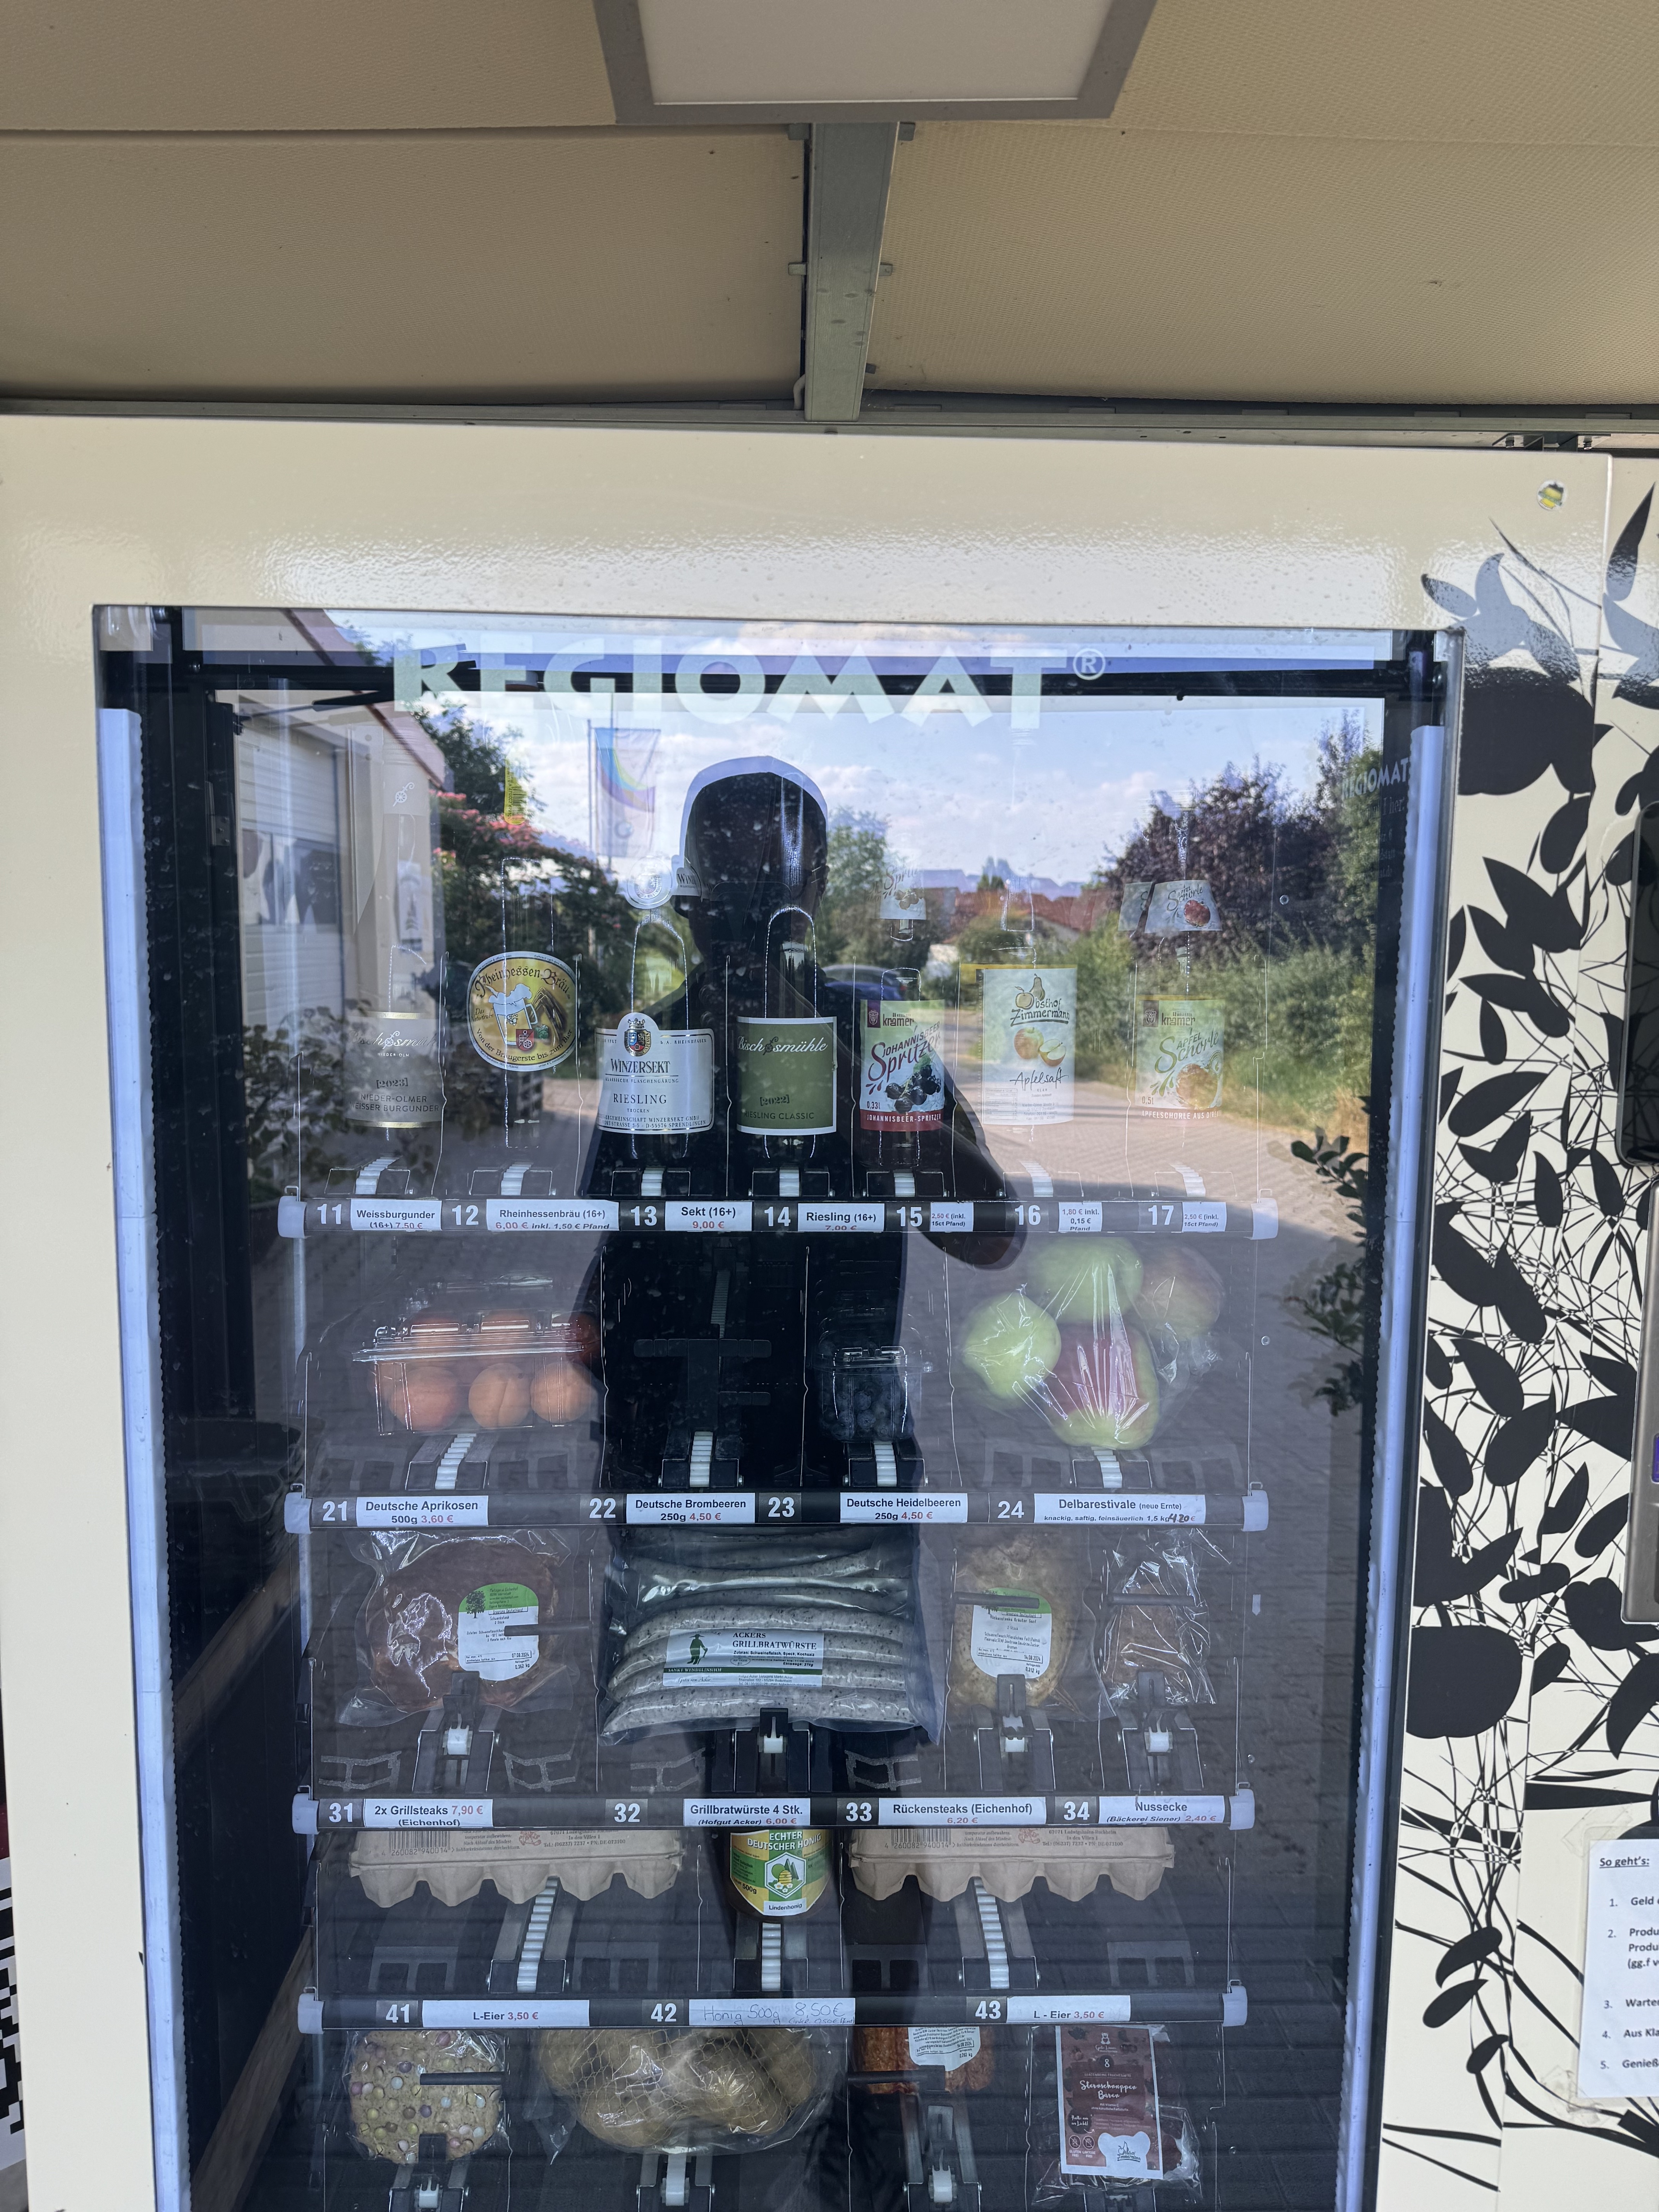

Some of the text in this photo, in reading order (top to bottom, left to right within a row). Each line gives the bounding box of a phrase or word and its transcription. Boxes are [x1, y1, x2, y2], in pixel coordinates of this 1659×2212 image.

[1010, 1009, 1070, 1025] Zimmermann
[1176, 1032, 1201, 1049] APFEL
[485, 1042, 495, 1052] der
[550, 1042, 563, 1055] zum
[611, 1058, 670, 1073] WINZERSEKT
[1010, 1067, 1069, 1091] Apfelsaft
[361, 1094, 427, 1103] NIEDER-OLMER
[613, 1093, 667, 1104] RIESLING
[867, 1114, 941, 1122] JOHANNISBEER-SPRITZER
[1142, 1110, 1190, 1120] APFELSCHORLE
[317, 1204, 342, 1224] 11
[357, 1210, 435, 1221] Weissburgunder
[452, 1205, 479, 1225] 12
[500, 1208, 605, 1219] Rheinhessenbräu (16+)
[630, 1206, 657, 1226] 13
[681, 1207, 736, 1219] Sekt (16+)
[764, 1206, 790, 1226] 14
[806, 1212, 876, 1223] Riesling (16+)
[897, 1206, 922, 1227] 15
[951, 1212, 965, 1221] (inkl.
[1015, 1205, 1041, 1225] 16
[1062, 1209, 1077, 1217] 1,80
[1148, 1205, 1174, 1225] 17
[692, 1221, 715, 1230] 9,00
[1070, 1218, 1084, 1226] 0,15
[366, 1501, 478, 1512] Deutsche Aprikosen
[589, 1498, 616, 1518] 22
[635, 1499, 746, 1508] Deutsche Brombeeren
[768, 1497, 795, 1517] 23
[847, 1498, 961, 1507] Deutsche Heidelbeeren
[1059, 1499, 1136, 1509] Delbarestivale
[322, 1501, 347, 1521] 21
[998, 1501, 1024, 1518] 24
[392, 1515, 443, 1524] 500g 3,60
[661, 1513, 711, 1522] 250g 4,50
[875, 1512, 923, 1521] 250g 4,50
[733, 1640, 817, 1650] GRILLBRATWÜRSTE
[375, 1805, 473, 1816] 2x Grillsteaks 7,90
[690, 1805, 802, 1815] Grillbratwürste 4 Stk.
[893, 1803, 1032, 1815] Rückensteaks (Eichenhof)
[1064, 1802, 1089, 1820] 34
[1136, 1802, 1187, 1811] Nussecke
[329, 1803, 353, 1822] 31
[615, 1803, 641, 1822] 32
[846, 1803, 872, 1822] 33
[399, 1819, 460, 1827] (Eichenhof)
[747, 1833, 821, 1850] DEUTSCHER HONIG
[769, 1831, 802, 1841] ECHTER
[1600, 1858, 1612, 1867] So
[742, 1883, 757, 1894] 500g
[1631, 1897, 1654, 1906] Geld
[1628, 1942, 1659, 1952] Produ
[975, 2001, 1001, 2019] 43
[1604, 2001, 1613, 2009] 3.
[386, 2004, 409, 2023] 41
[473, 2012, 529, 2021] L-Eier 3,50
[651, 2003, 677, 2022] 42
[704, 2005, 742, 2025] Honig
[1051, 2010, 1095, 2020] Eier 3,50
[1623, 2029, 1643, 2038] Aus
[1104, 2059, 1110, 2068] 8
[1601, 2061, 1609, 2069] 5.
